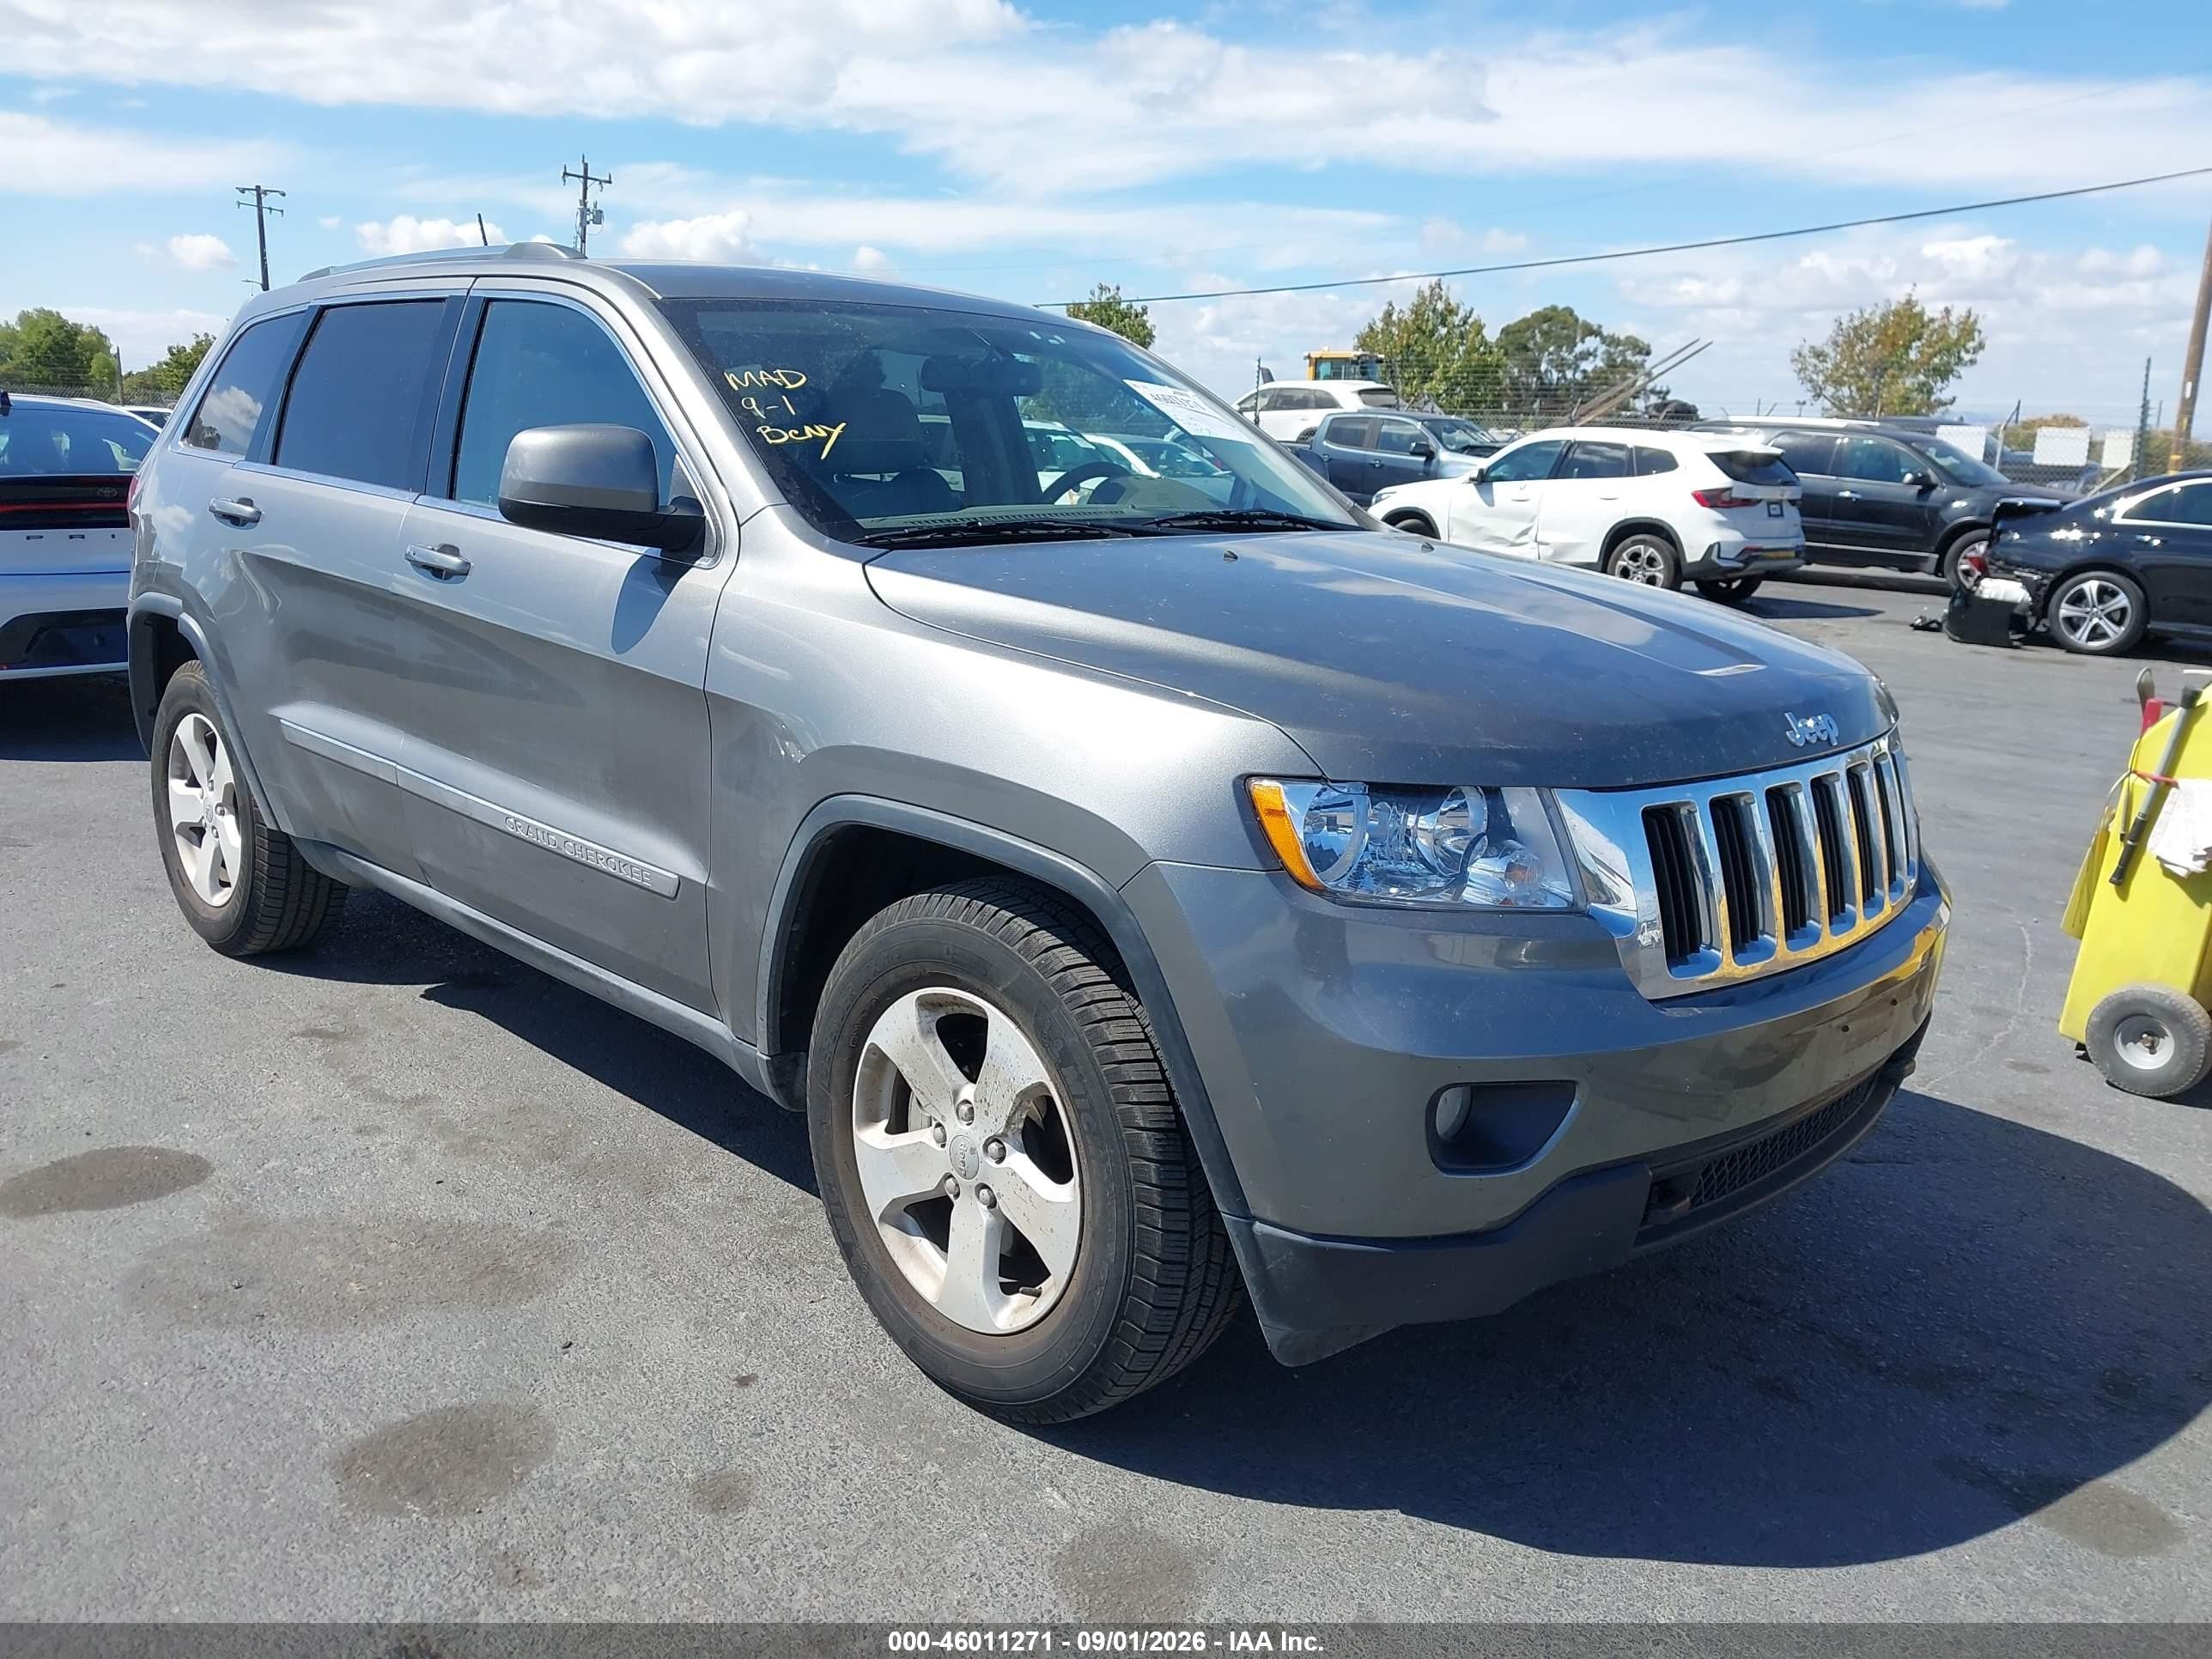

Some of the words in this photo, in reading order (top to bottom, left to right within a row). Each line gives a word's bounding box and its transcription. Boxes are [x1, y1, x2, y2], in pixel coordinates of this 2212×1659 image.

[723, 369, 807, 391] MAD
[741, 395, 796, 419] 9-1
[1784, 711, 1839, 748] Jeep
[504, 816, 558, 849] GRAND
[562, 839, 653, 886] CHEROKEE
